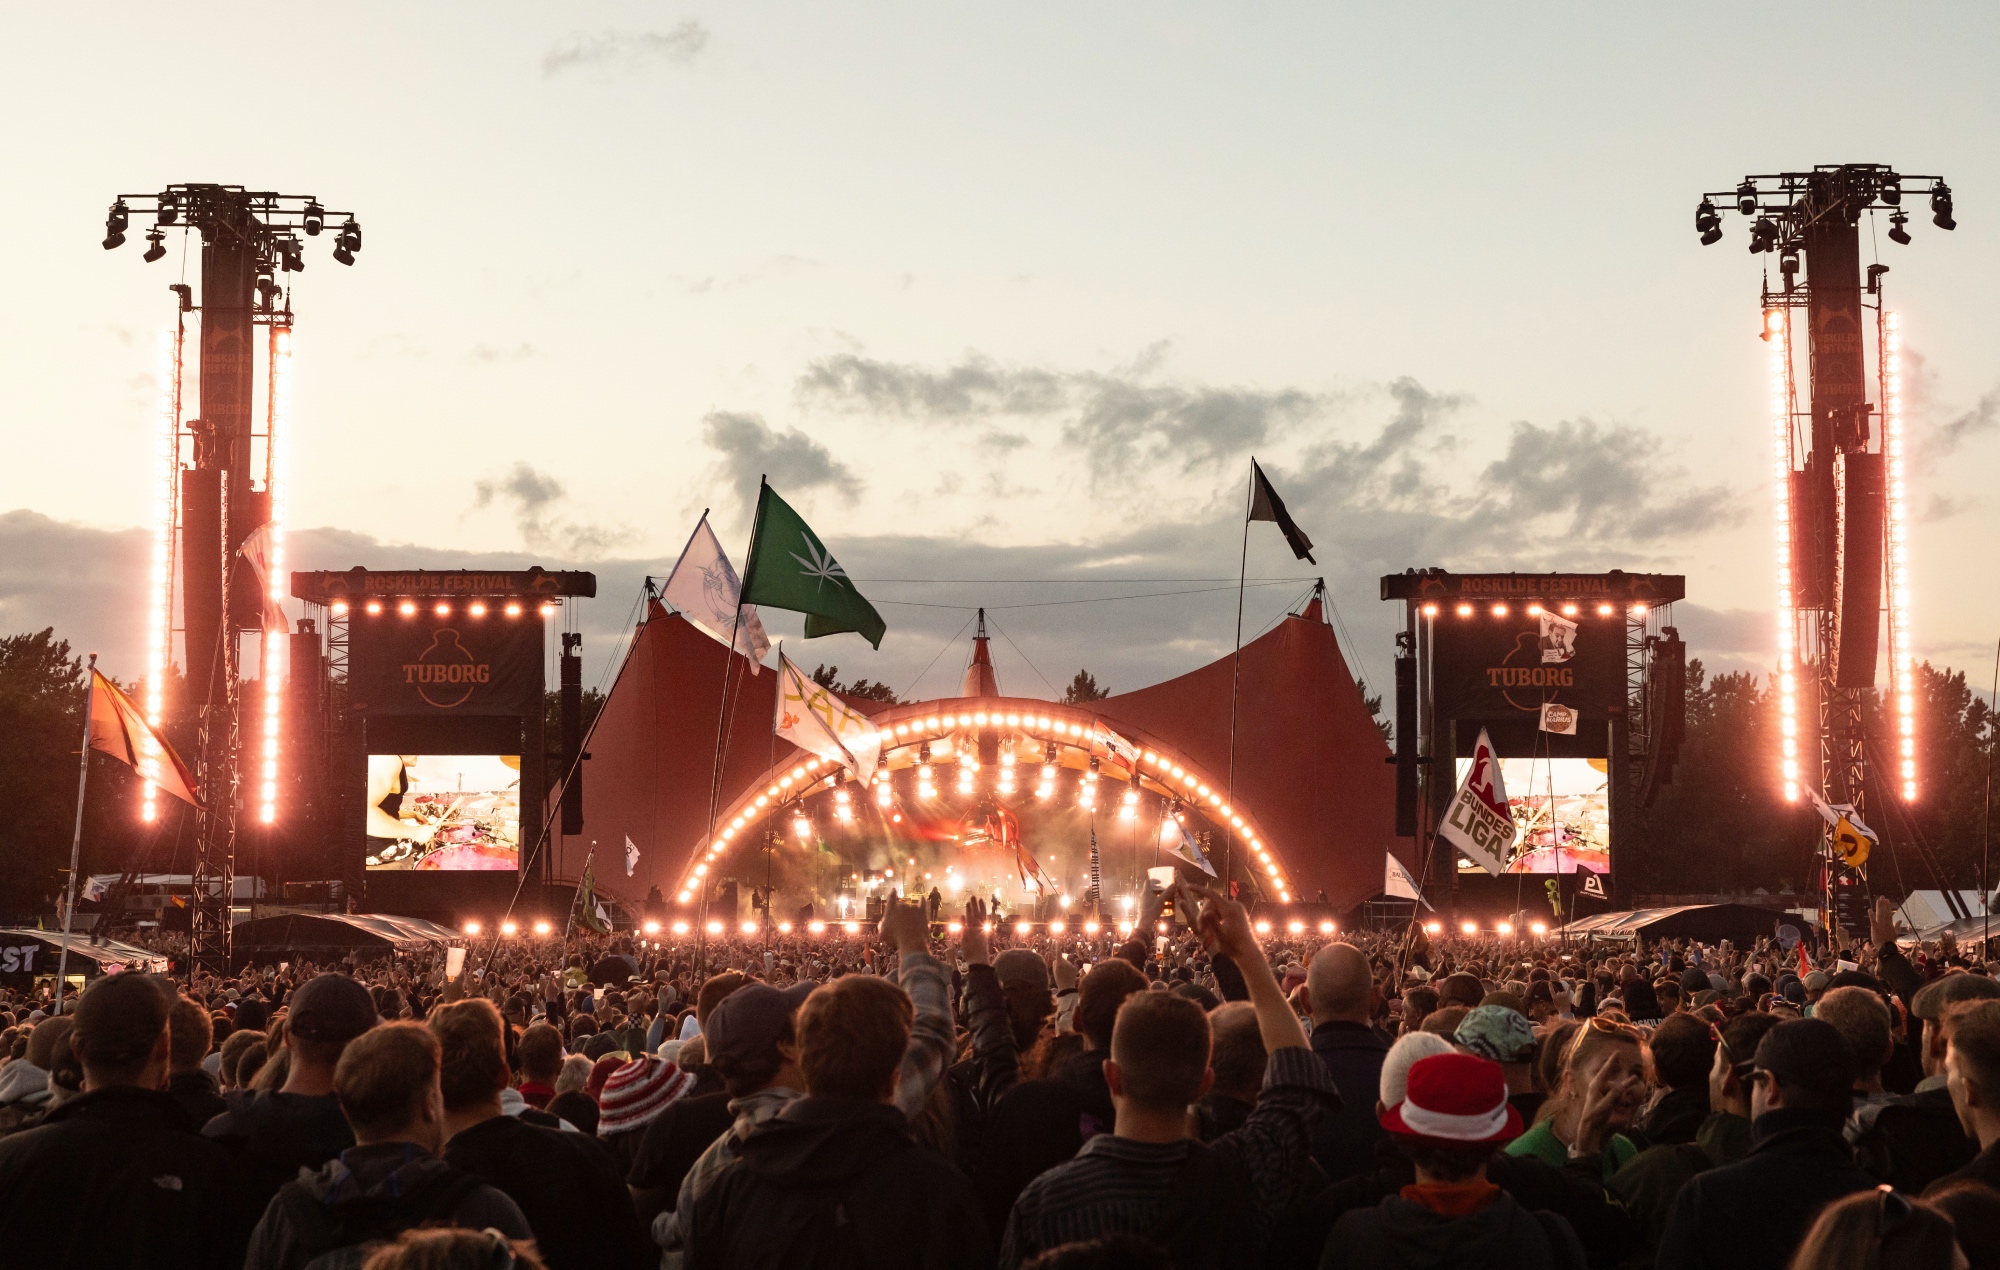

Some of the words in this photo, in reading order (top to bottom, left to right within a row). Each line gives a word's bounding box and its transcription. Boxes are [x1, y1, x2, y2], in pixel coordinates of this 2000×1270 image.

[365, 575, 440, 590] ROSKILDE
[444, 575, 514, 590] FESTIVAL
[1461, 578, 1537, 592] ROSKILDE
[1541, 578, 1610, 592] FESTIVAL
[403, 664, 490, 683] TUBORG
[1486, 667, 1573, 687] TUBORG
[1460, 789, 1514, 840] BUNDES
[1448, 802, 1503, 863] LIGA
[0, 945, 40, 973] ST
